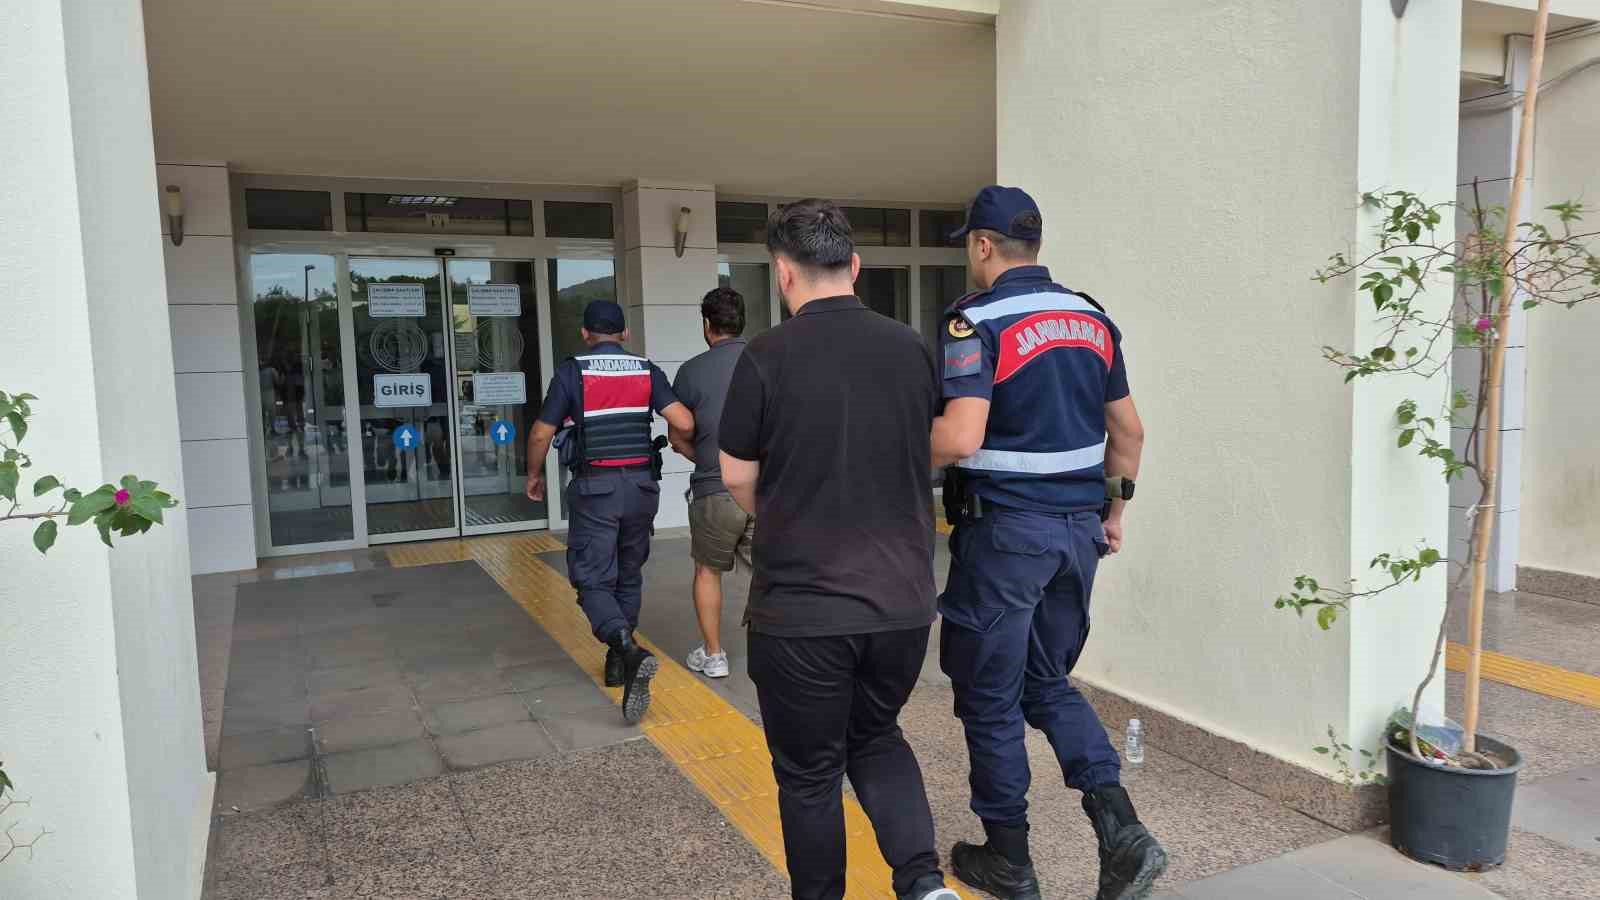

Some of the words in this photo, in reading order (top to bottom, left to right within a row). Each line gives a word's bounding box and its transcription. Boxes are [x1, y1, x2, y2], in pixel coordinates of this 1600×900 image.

[1015, 318, 1105, 356] JANDARMA
[588, 359, 642, 370] JANDARMA
[381, 382, 425, 398] GİRİŞ
